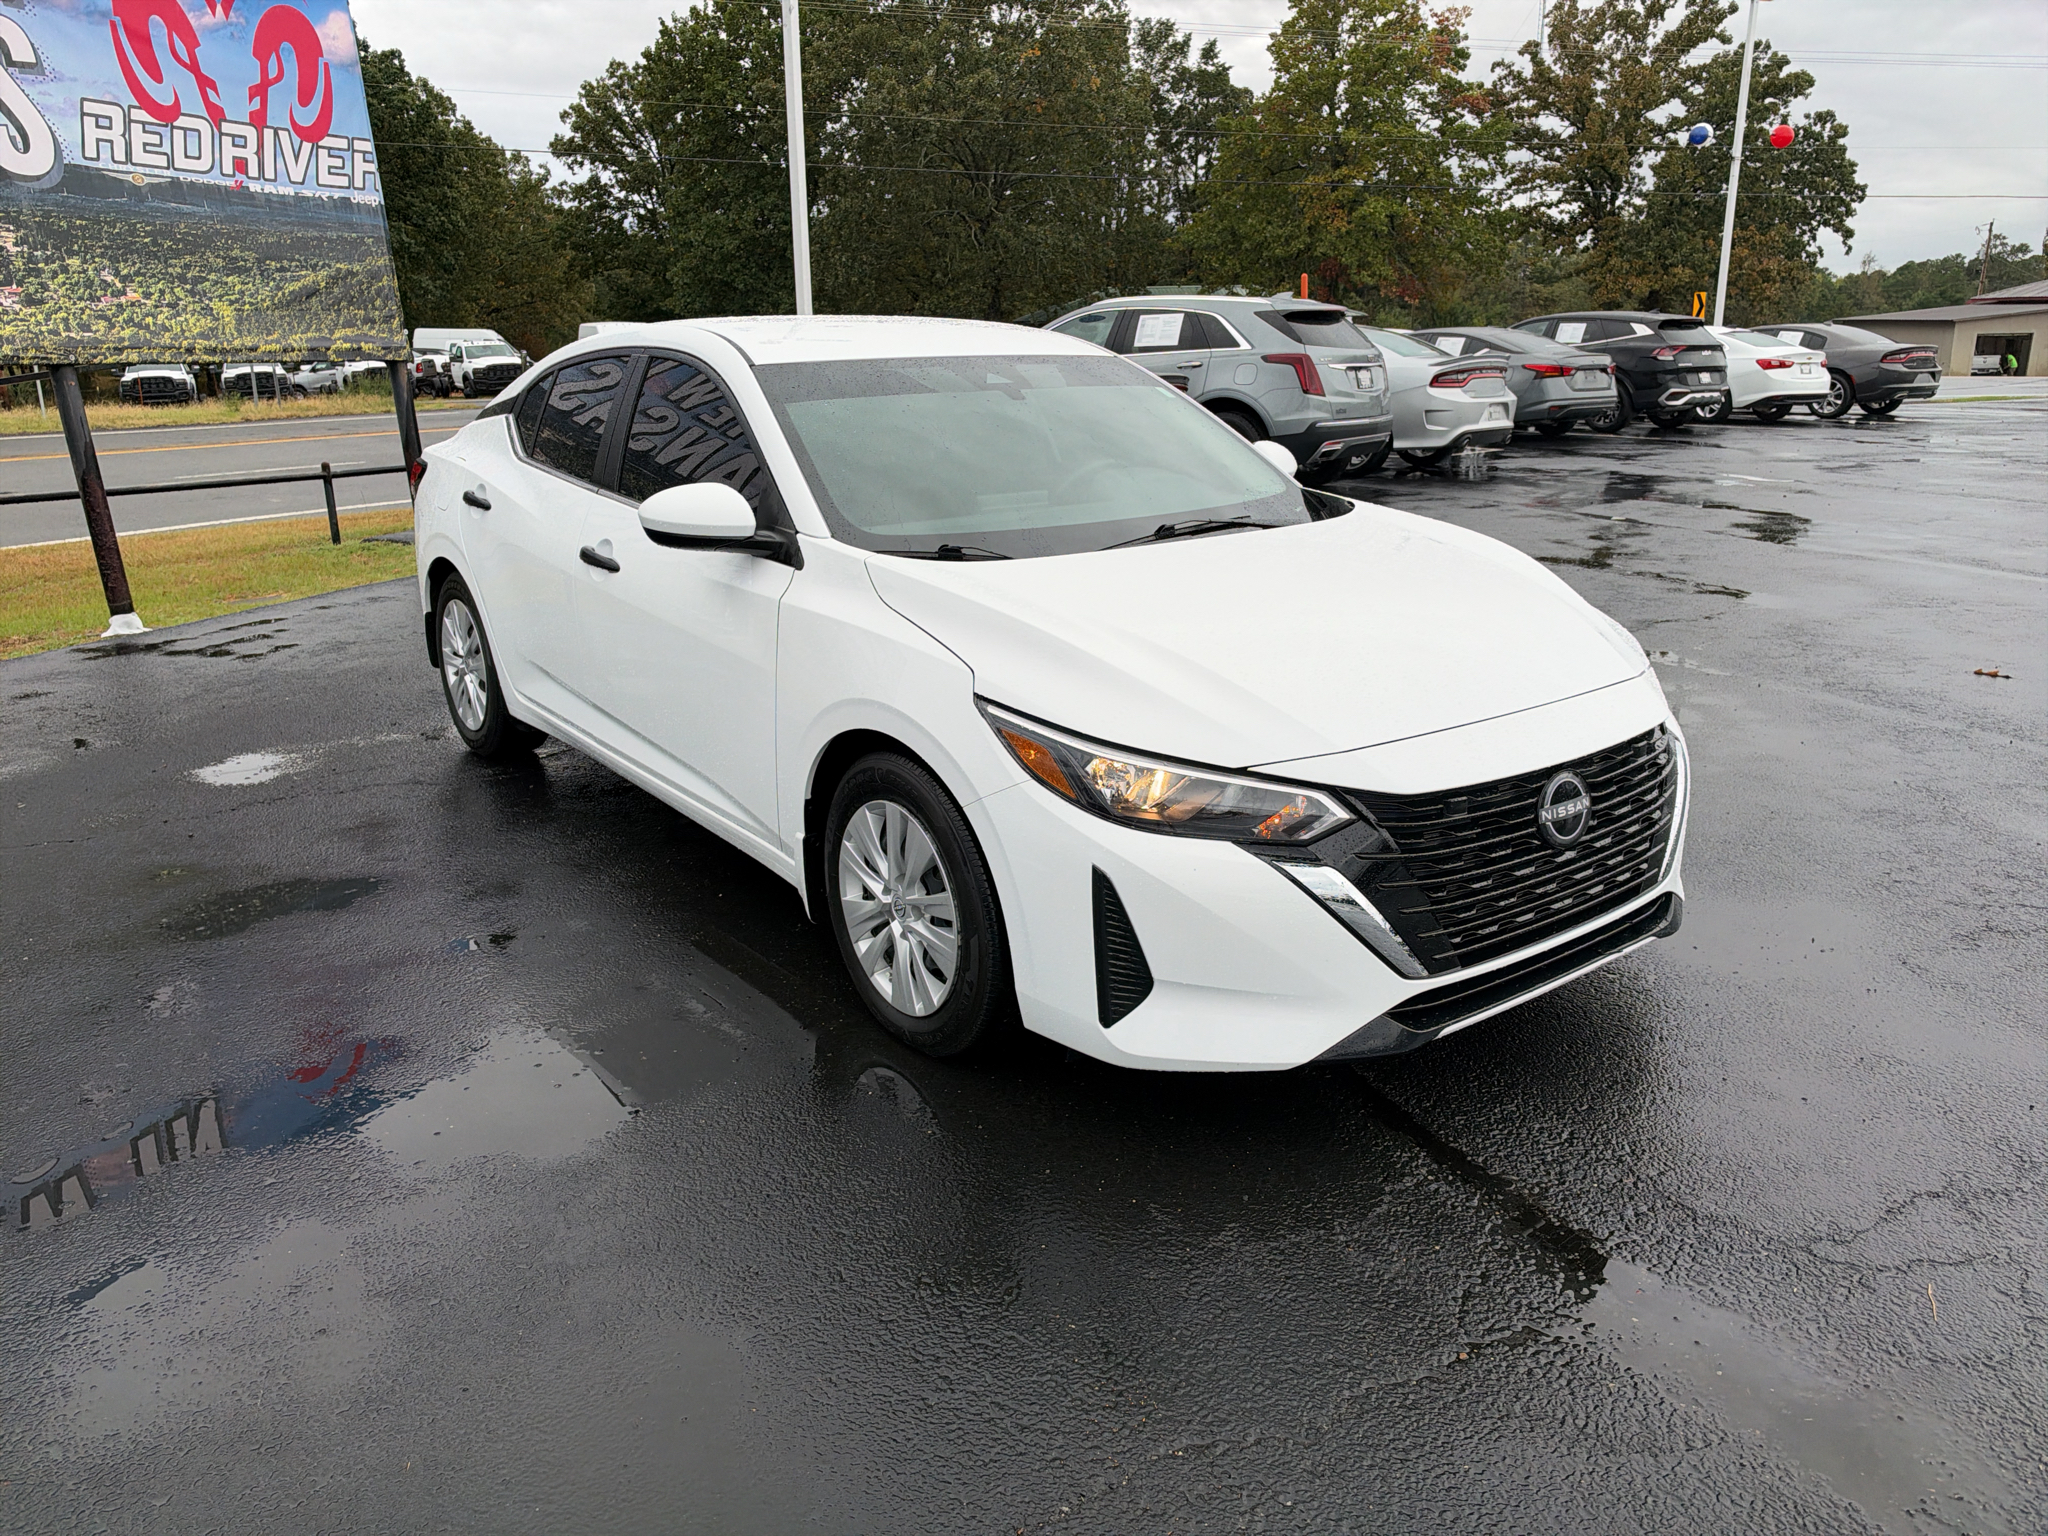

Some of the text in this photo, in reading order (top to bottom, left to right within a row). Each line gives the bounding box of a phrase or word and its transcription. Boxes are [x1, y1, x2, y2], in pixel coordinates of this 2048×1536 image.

[180, 176, 237, 187] DODGE
[248, 183, 295, 197] RAM
[298, 189, 345, 201] SRT
[350, 191, 380, 208] Jeep
[1541, 797, 1590, 822] NISSAN
